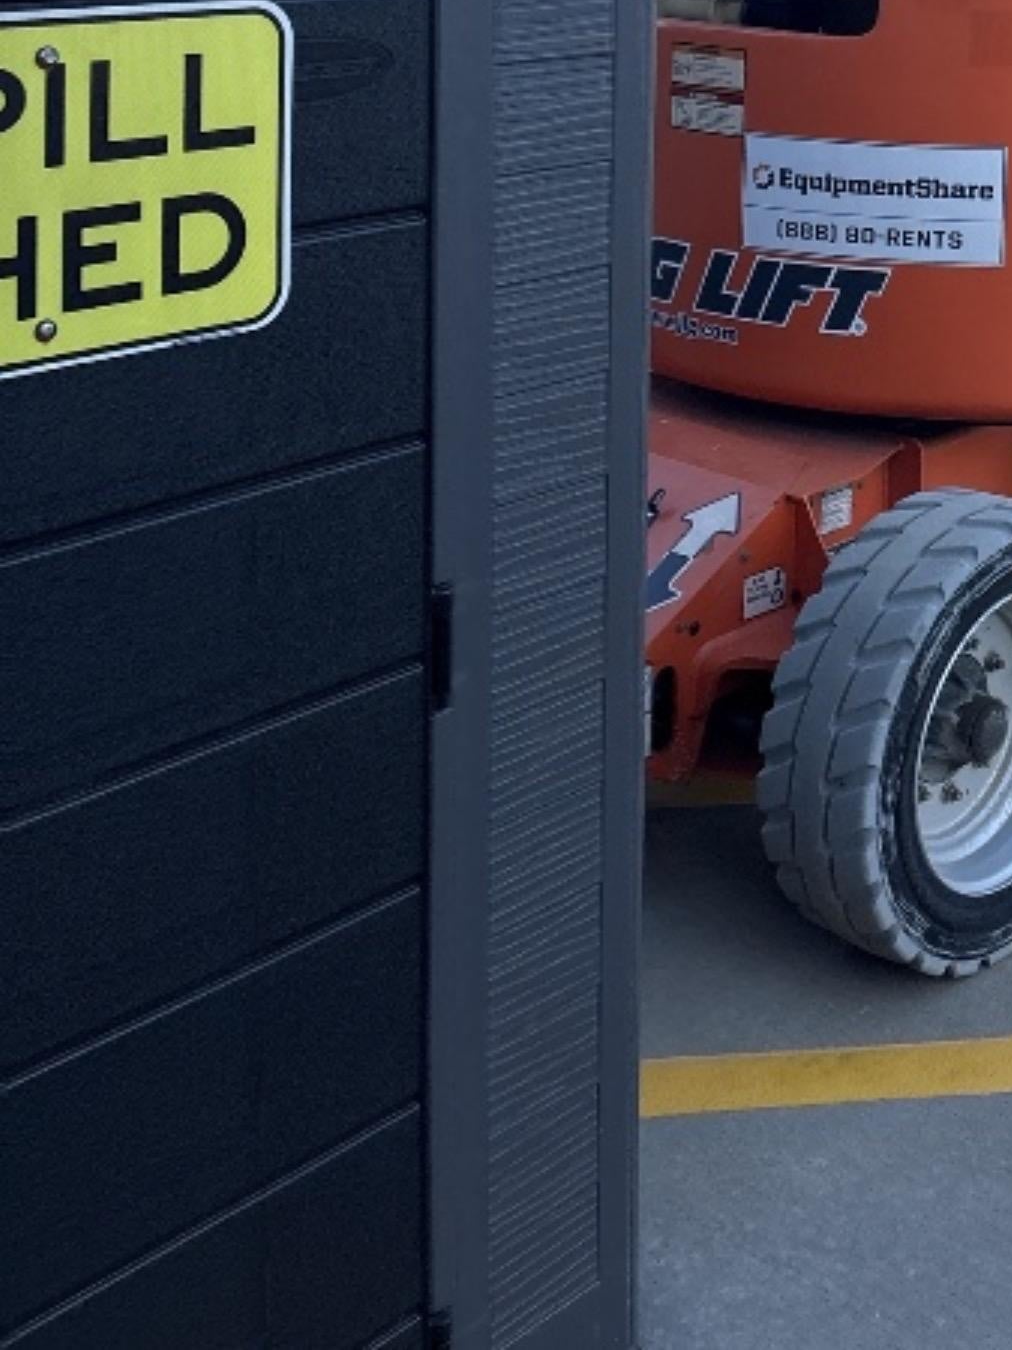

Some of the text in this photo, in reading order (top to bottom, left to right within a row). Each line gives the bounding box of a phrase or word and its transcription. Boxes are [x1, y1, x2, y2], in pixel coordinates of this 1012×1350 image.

[779, 167, 994, 201] EquipmentShare
[776, 218, 964, 250] (888) 80-RENTS
[693, 248, 892, 335] LIFT
